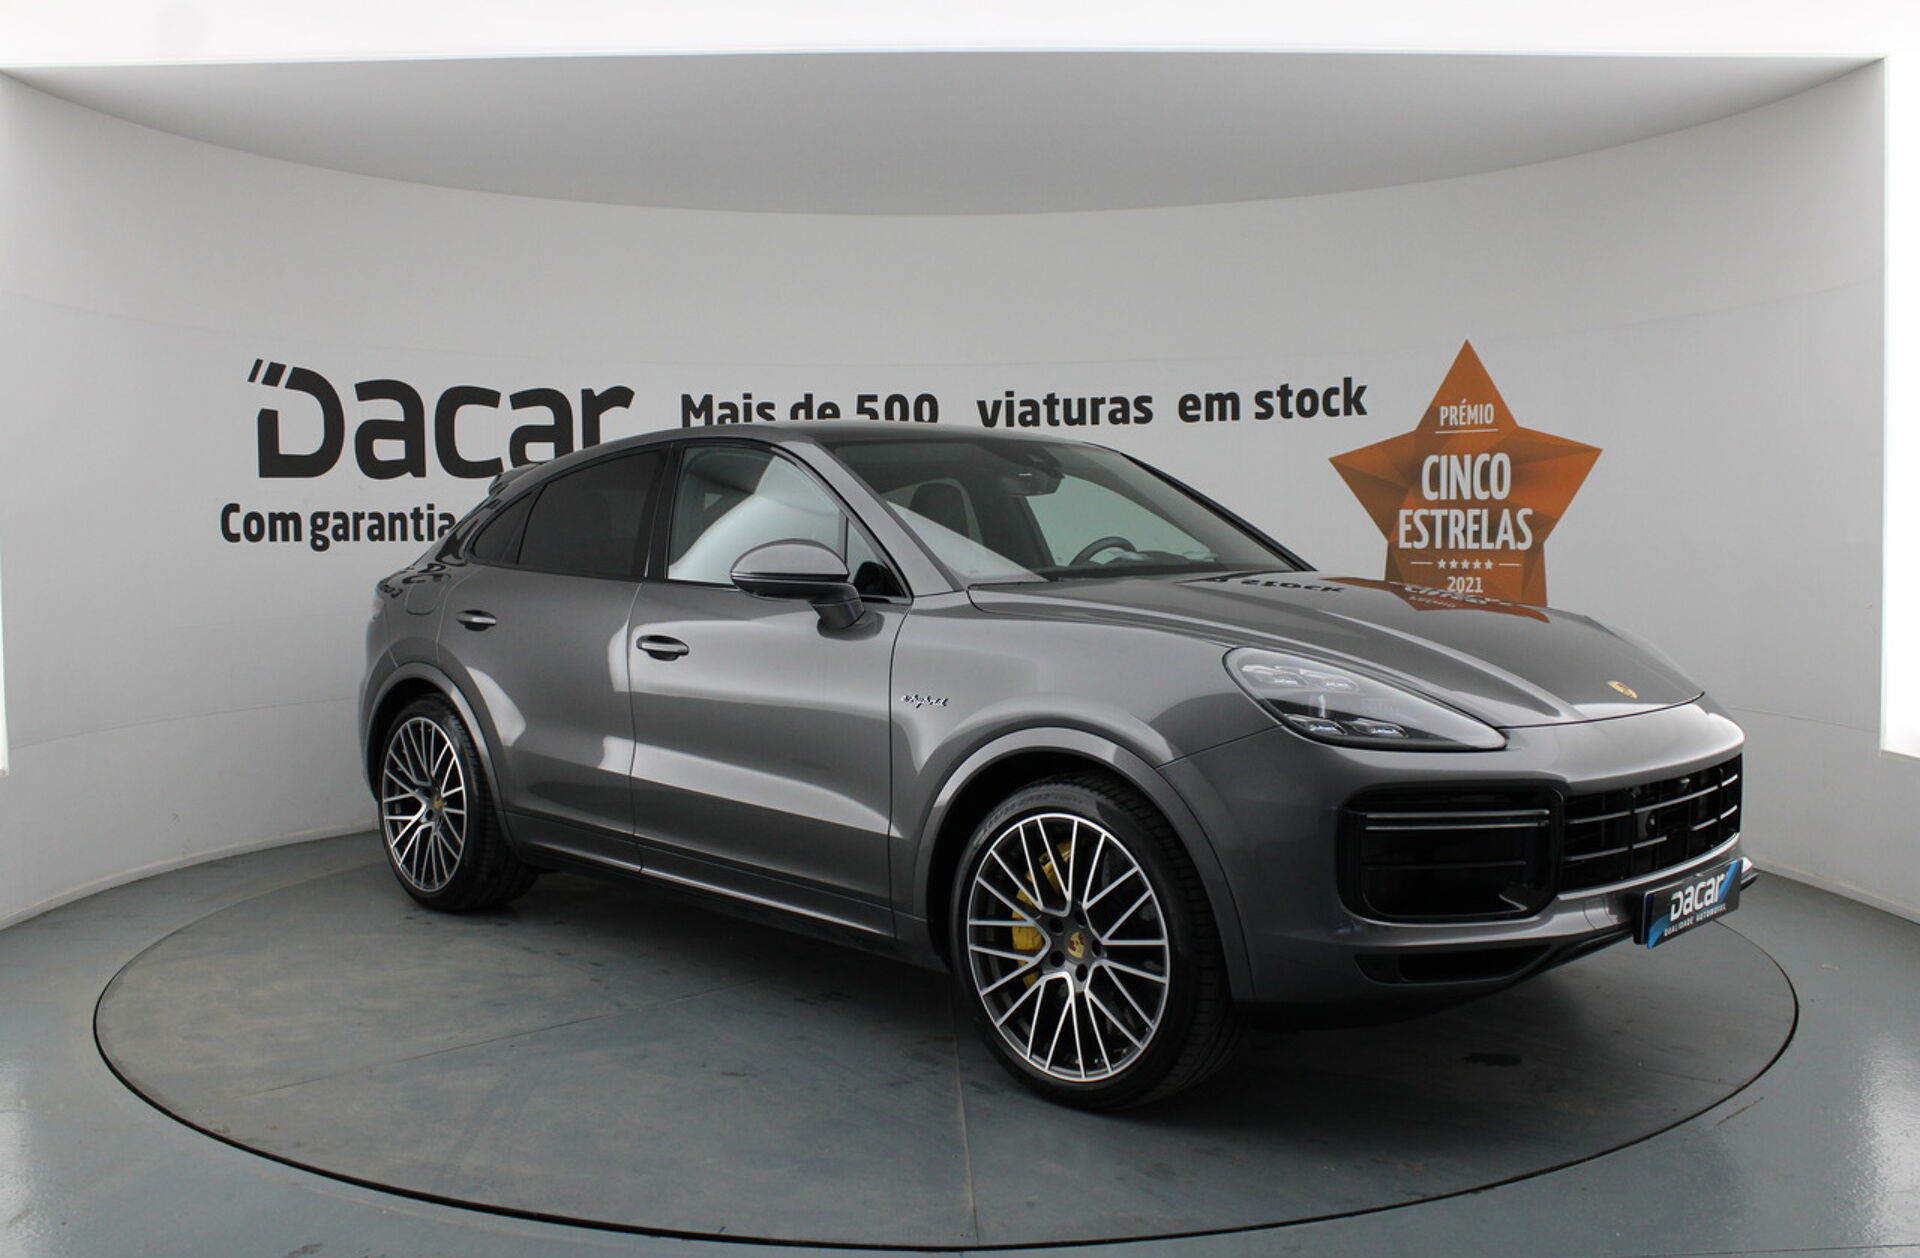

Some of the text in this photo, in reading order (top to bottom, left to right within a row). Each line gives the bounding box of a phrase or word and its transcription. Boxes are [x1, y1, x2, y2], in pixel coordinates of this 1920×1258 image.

[247, 358, 635, 480] Dacar
[681, 377, 1368, 428] Mais de 500 viaturas em stock
[1439, 398, 1495, 426] PRÉMIO
[1421, 452, 1512, 501] CINCO
[220, 502, 457, 552] Com garantia
[1398, 507, 1534, 551] ESTRELAS
[1447, 576, 1483, 593] 2021
[1670, 872, 1726, 922] Dacar
